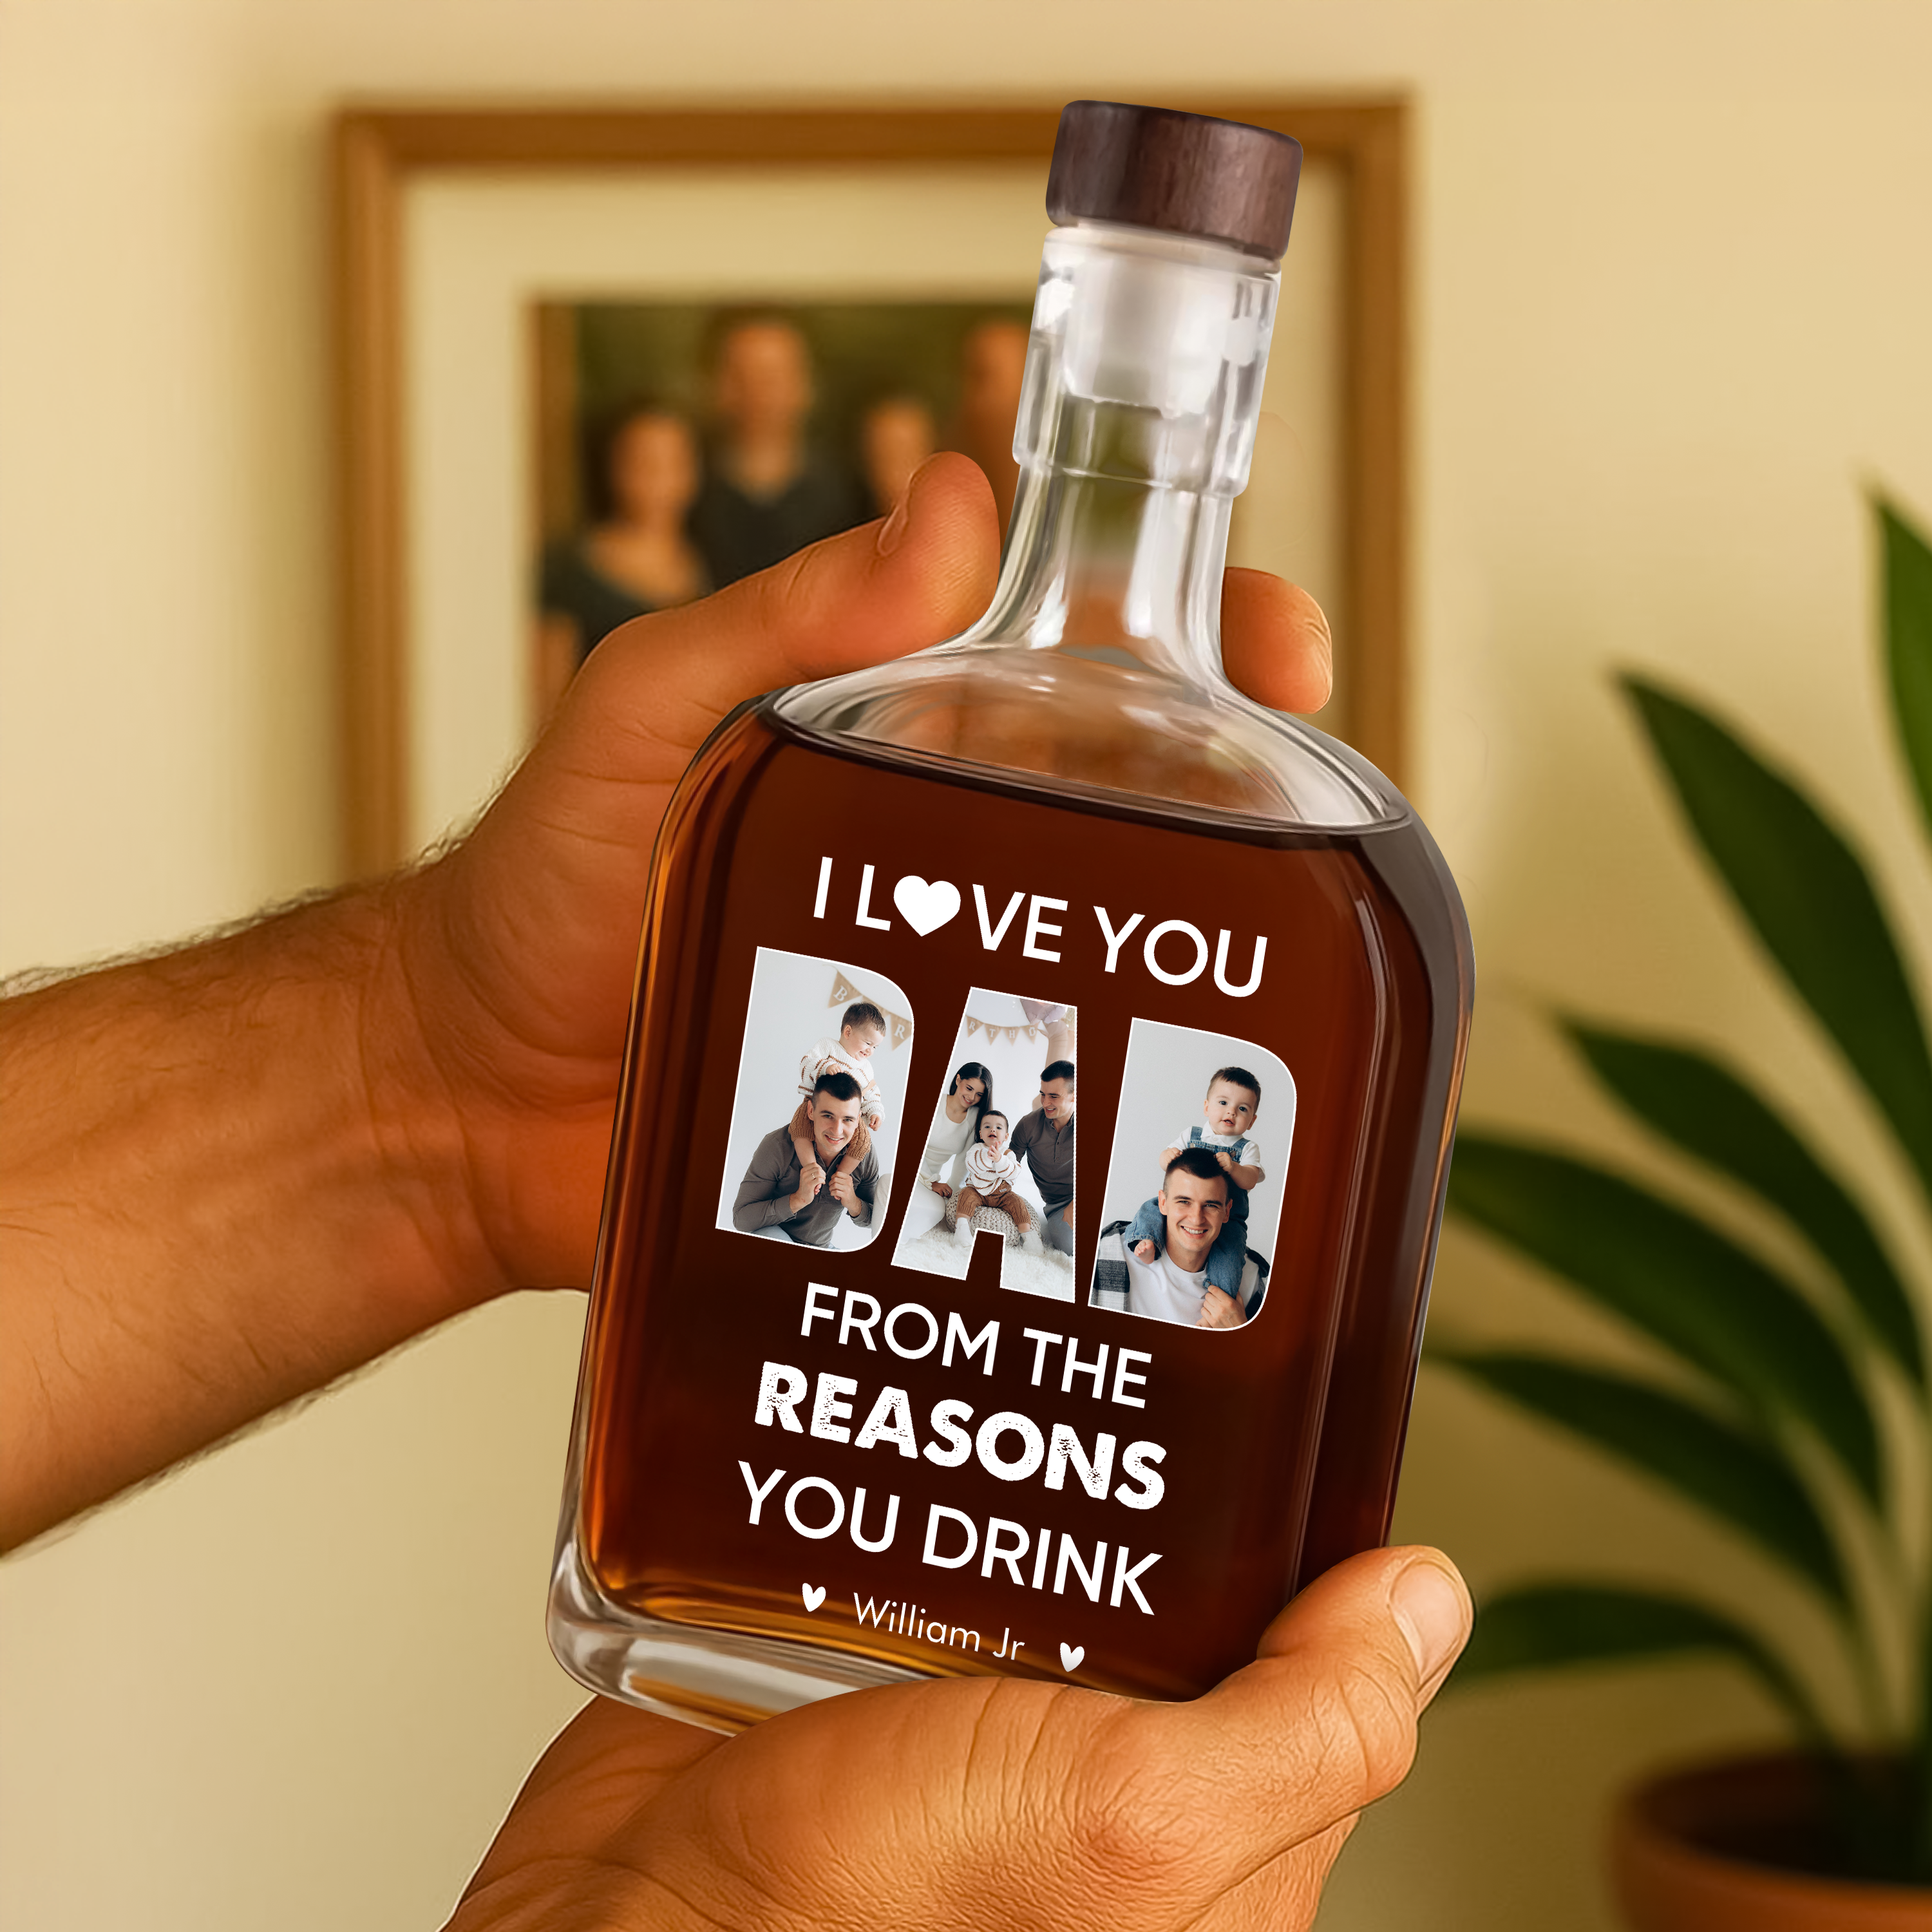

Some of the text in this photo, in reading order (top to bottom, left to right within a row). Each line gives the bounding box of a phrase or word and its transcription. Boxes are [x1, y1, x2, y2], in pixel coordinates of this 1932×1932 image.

[813, 856, 833, 919] I
[1093, 905, 1268, 998] YOU
[715, 945, 1297, 1332] DAD
[800, 1282, 1152, 1409] FROM THE
[754, 1361, 1167, 1510] REASONS
[737, 1460, 1163, 1616] YOU DRINK
[853, 1592, 1025, 1661] William Jr
